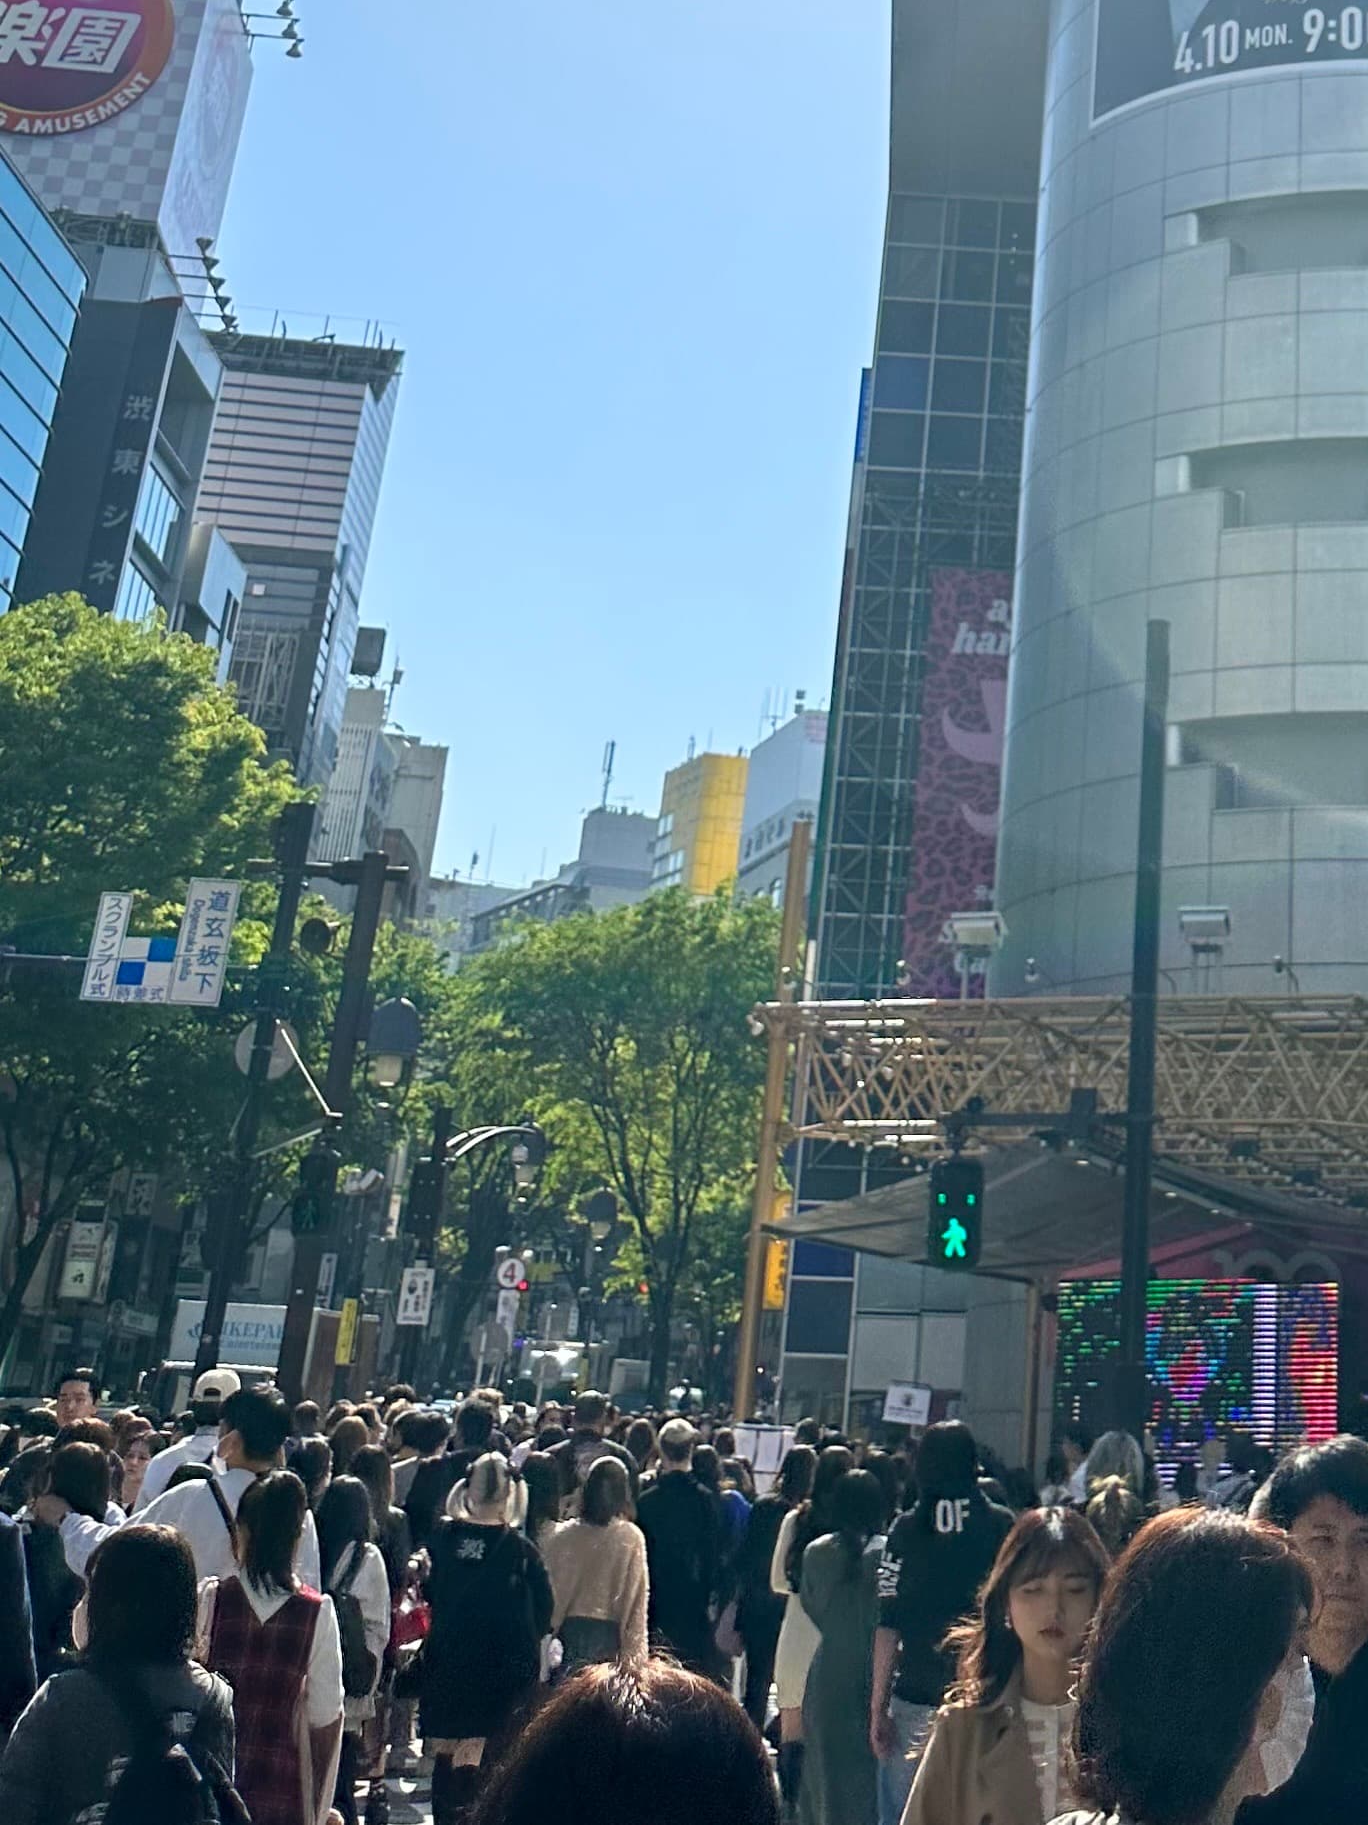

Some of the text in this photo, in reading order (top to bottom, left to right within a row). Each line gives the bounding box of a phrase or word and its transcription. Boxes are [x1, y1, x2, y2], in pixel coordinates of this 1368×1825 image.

[1174, 19, 1240, 74] 4.10
[1244, 23, 1294, 50] MON.
[13, 70, 151, 135] AMUSEMENT
[194, 889, 232, 995] 道玄坂下
[502, 1262, 518, 1284] 4
[935, 1498, 971, 1533] OF
